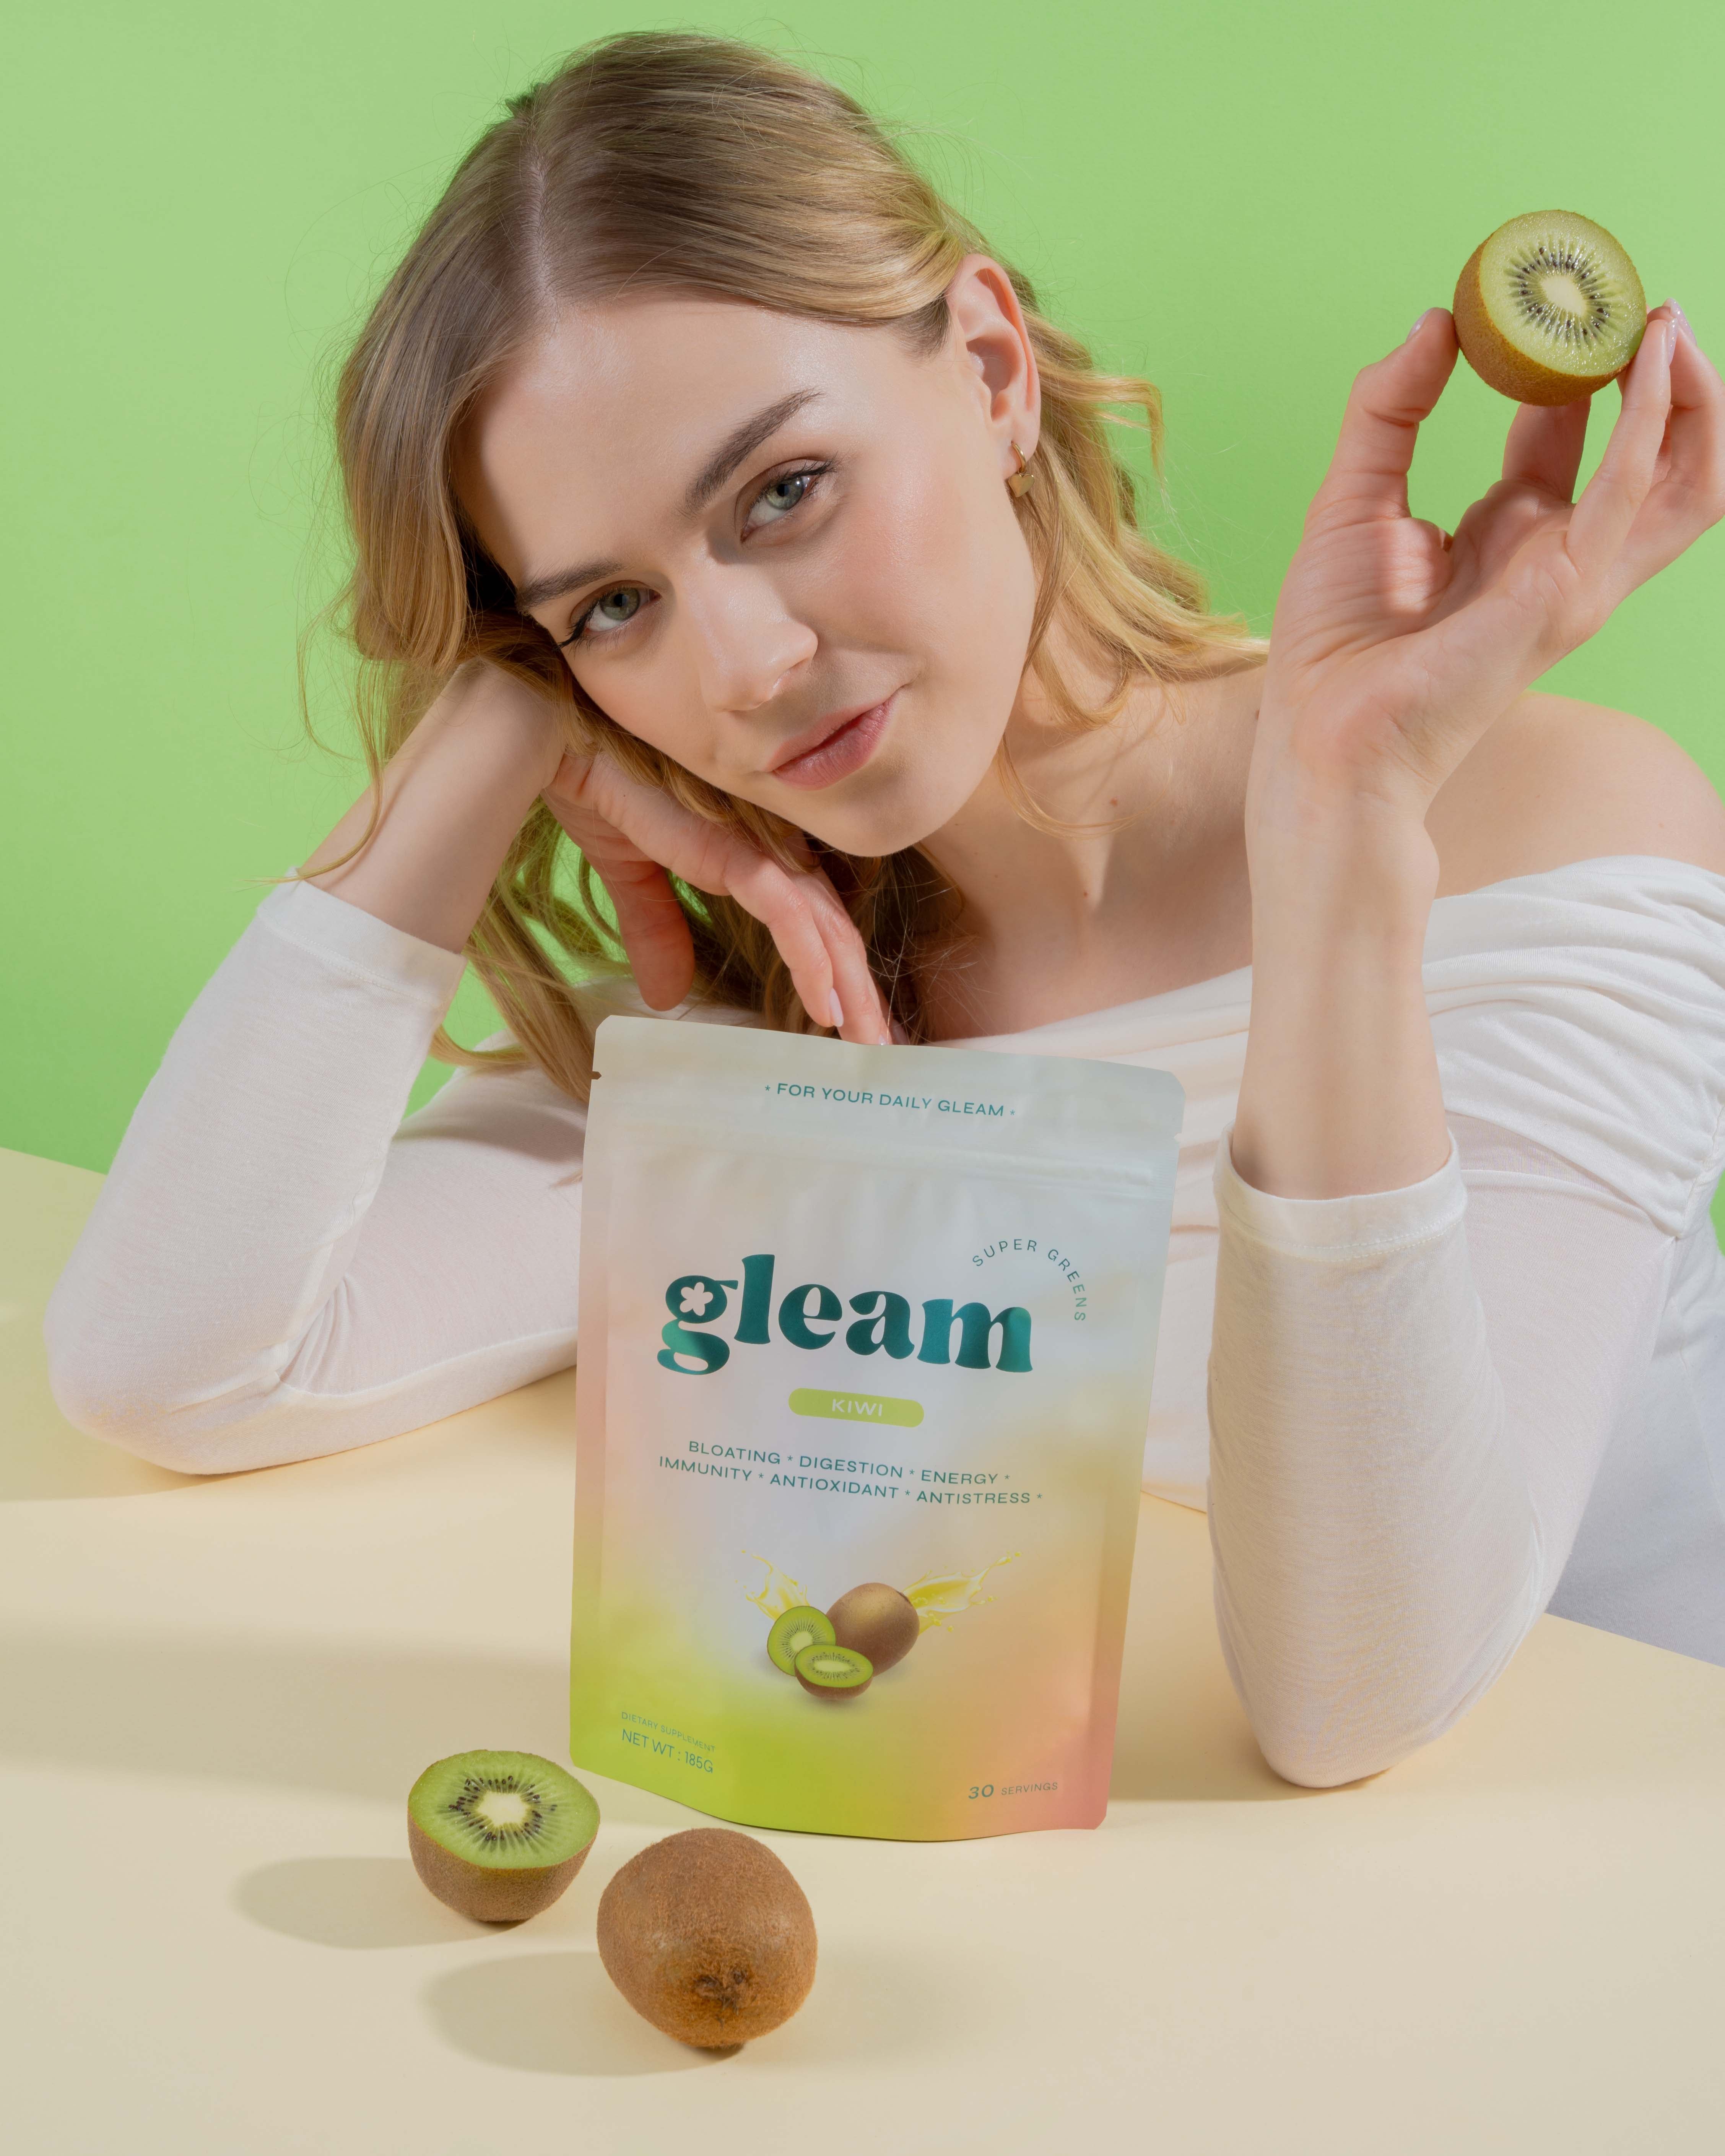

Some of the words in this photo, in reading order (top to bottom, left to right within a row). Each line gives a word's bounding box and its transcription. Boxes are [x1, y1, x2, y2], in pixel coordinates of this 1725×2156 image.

[777, 1082, 815, 1098] FOR
[821, 1087, 873, 1104] YOUR
[879, 1093, 932, 1110] DAILY
[937, 1099, 1004, 1117] GLEAM
[972, 1238, 1037, 1267] SUPER
[1047, 1249, 1087, 1321] GREENS
[657, 1254, 1033, 1375] gleam
[832, 1398, 884, 1417] KIWI
[659, 1456, 753, 1482] IMMUNITY
[769, 1473, 899, 1499] ANTIOXIDANT
[916, 1490, 1030, 1505] ANTISTRESS
[689, 1440, 780, 1465] BLOATING
[799, 1455, 903, 1478] DIGESTION
[920, 1469, 998, 1485] ENERGY
[621, 1711, 658, 1730] DIETARY
[660, 1725, 716, 1753] SUPPLEMENT
[622, 1728, 649, 1748] NET
[652, 1738, 675, 1759] WT
[685, 1751, 714, 1774] 185G
[968, 1784, 995, 1800] 30
[1001, 1782, 1058, 1796] SERVINGS
